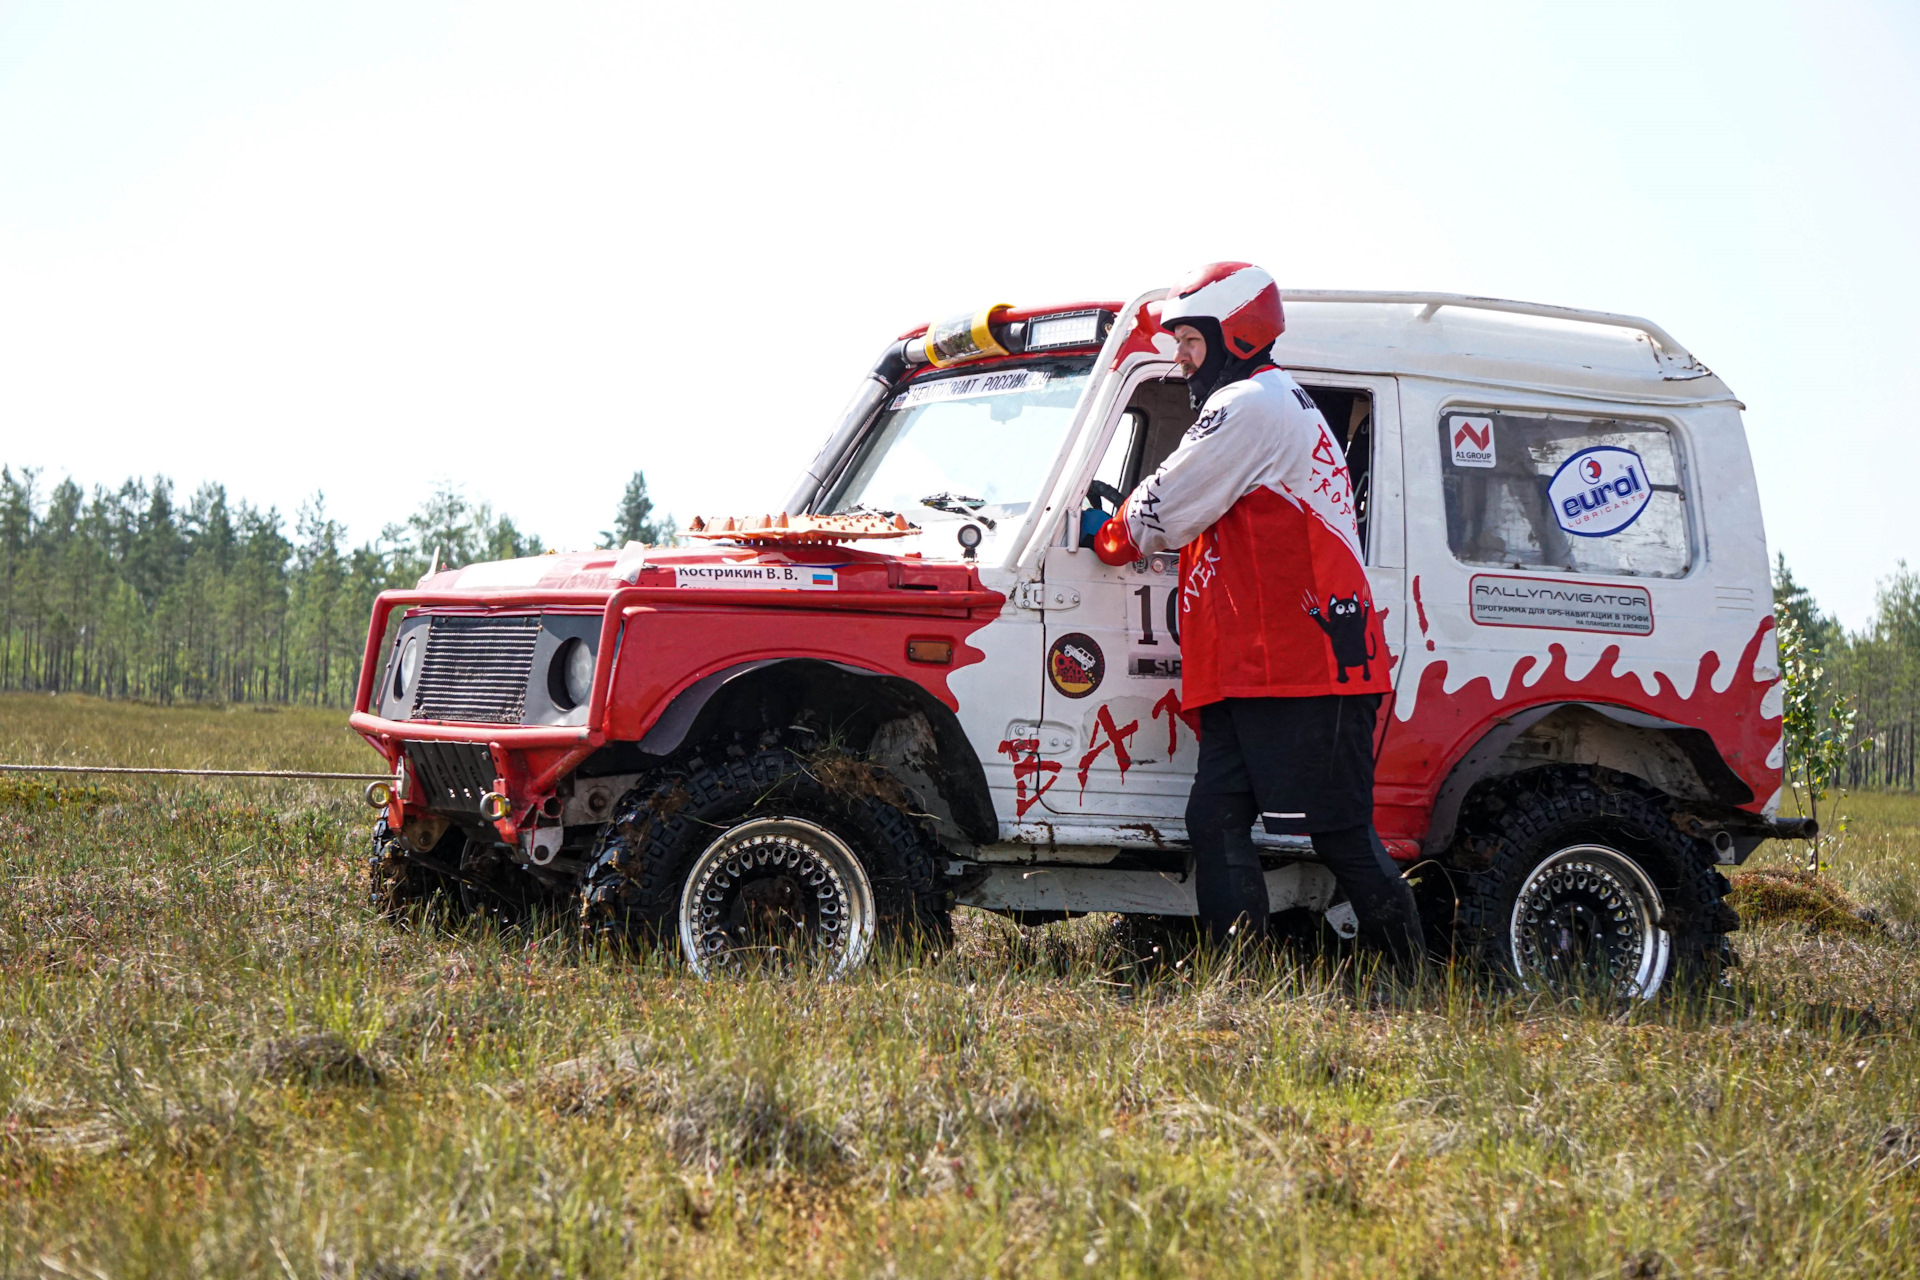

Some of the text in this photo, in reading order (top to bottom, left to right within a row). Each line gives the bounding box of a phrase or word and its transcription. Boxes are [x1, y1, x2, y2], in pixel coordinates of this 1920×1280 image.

[1466, 451, 1491, 460] GROUP
[1562, 464, 1642, 519] eurol
[1567, 492, 1645, 528] LUBRICANTS
[679, 566, 763, 580] Кострикин
[1477, 604, 1527, 614] ПРОГРАММА
[1528, 607, 1545, 615] ДЛЯ
[1547, 608, 1613, 620] GPS-НАВИГАЦИИ
[1622, 614, 1649, 623] ТРОФИ
